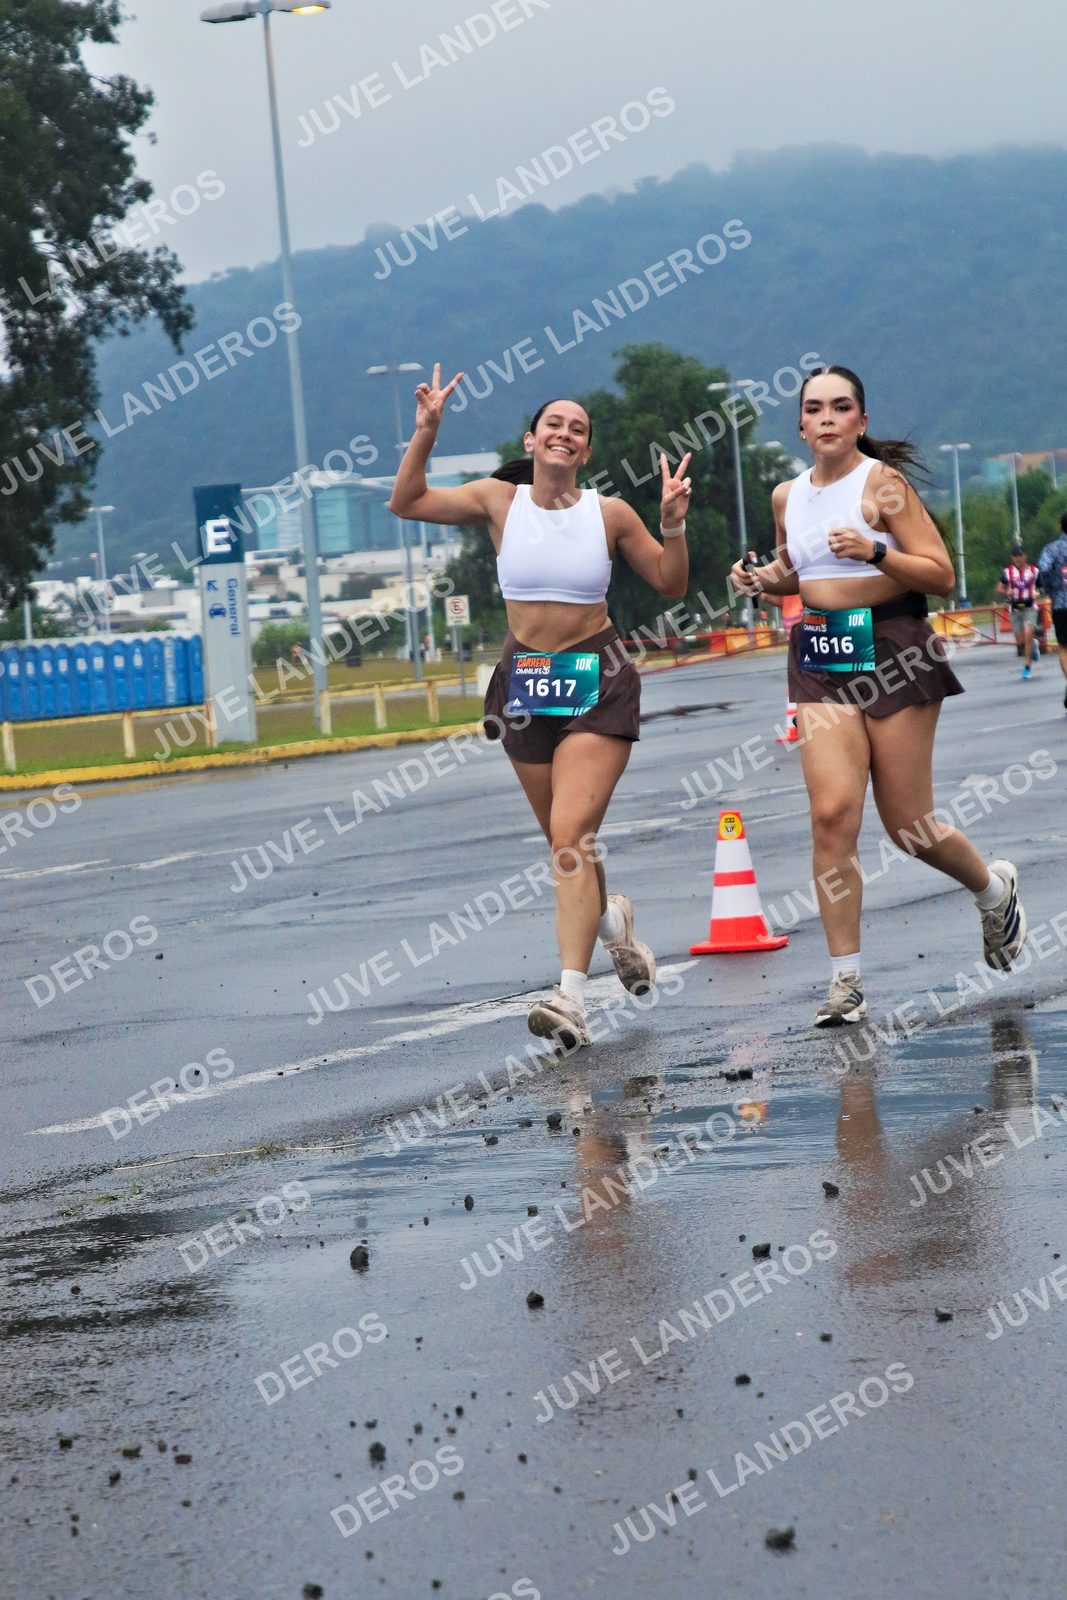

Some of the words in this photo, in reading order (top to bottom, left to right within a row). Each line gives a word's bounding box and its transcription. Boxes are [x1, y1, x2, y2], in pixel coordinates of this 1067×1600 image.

[206, 518, 232, 554] E
[226, 577, 241, 636] General
[848, 613, 865, 627] 10K
[810, 635, 855, 654] 1616
[516, 657, 551, 668] CARRERA
[575, 657, 593, 671] 10K
[525, 678, 577, 697] 1617
